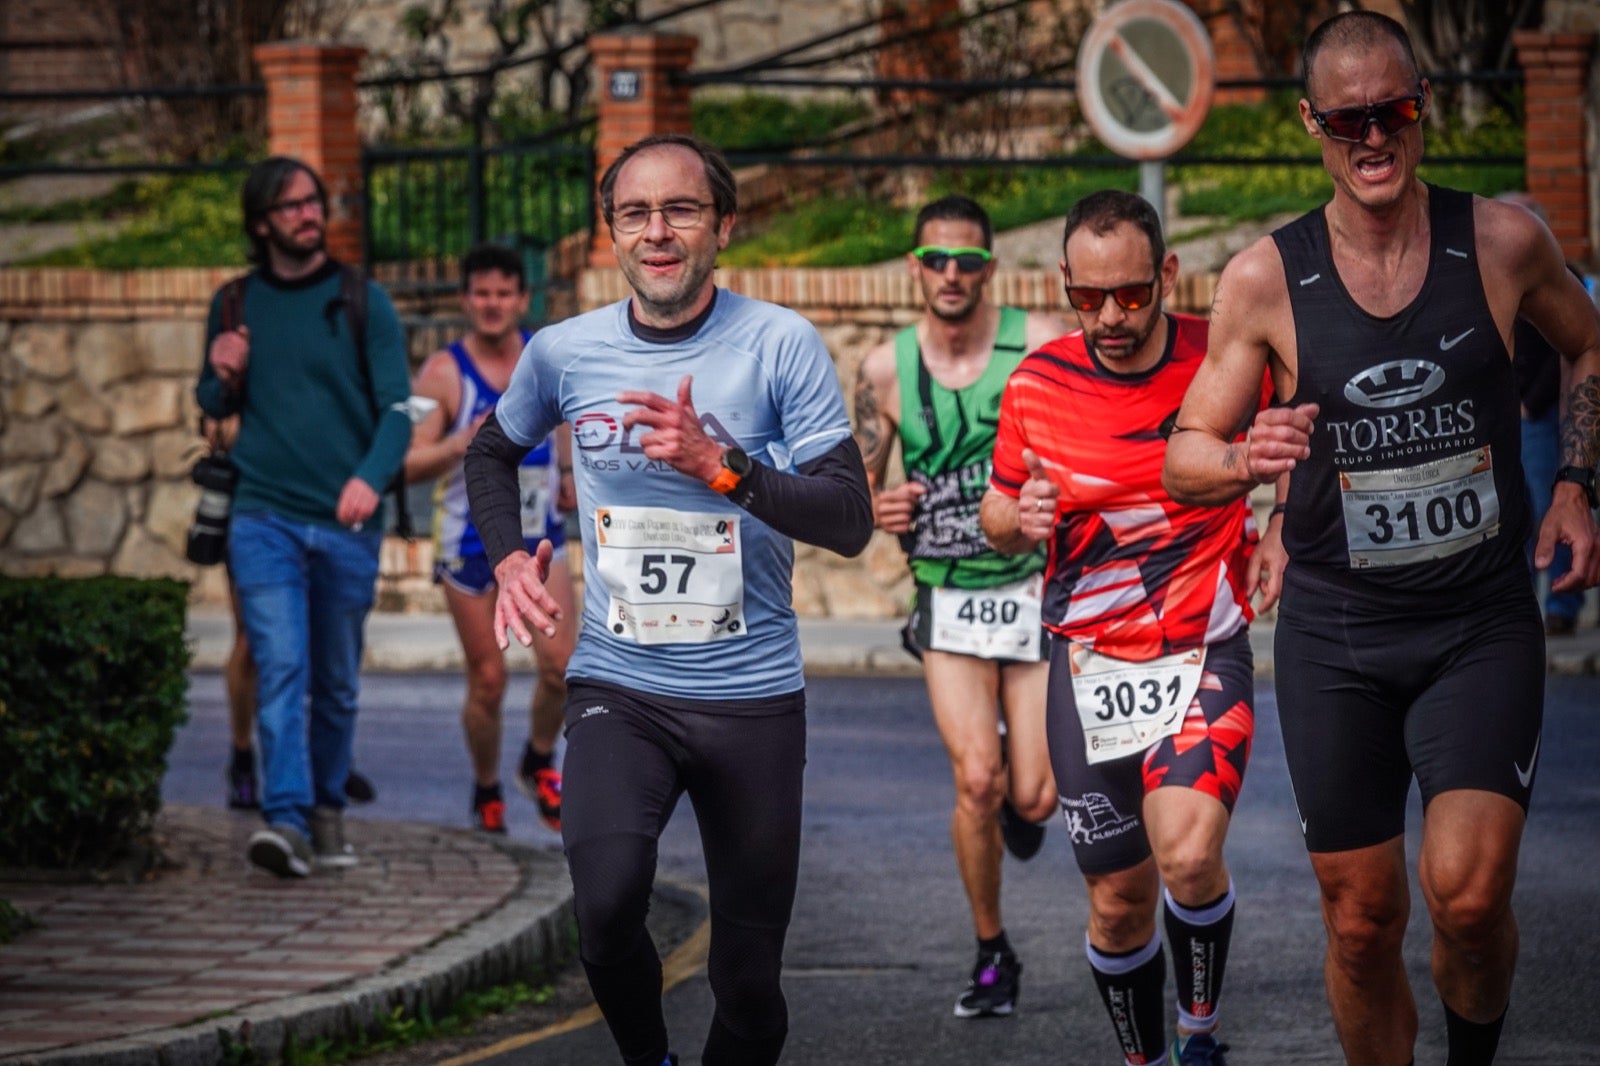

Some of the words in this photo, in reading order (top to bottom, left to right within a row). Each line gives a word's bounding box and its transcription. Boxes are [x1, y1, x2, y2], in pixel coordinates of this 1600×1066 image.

[1326, 399, 1476, 453] TORRES
[1334, 455, 1373, 465] GRUPO
[1381, 437, 1476, 460] INMOBILIARIO
[1365, 488, 1482, 545] 3100
[639, 554, 697, 595] 57
[957, 597, 1019, 625] 480
[1093, 674, 1181, 722] 3031
